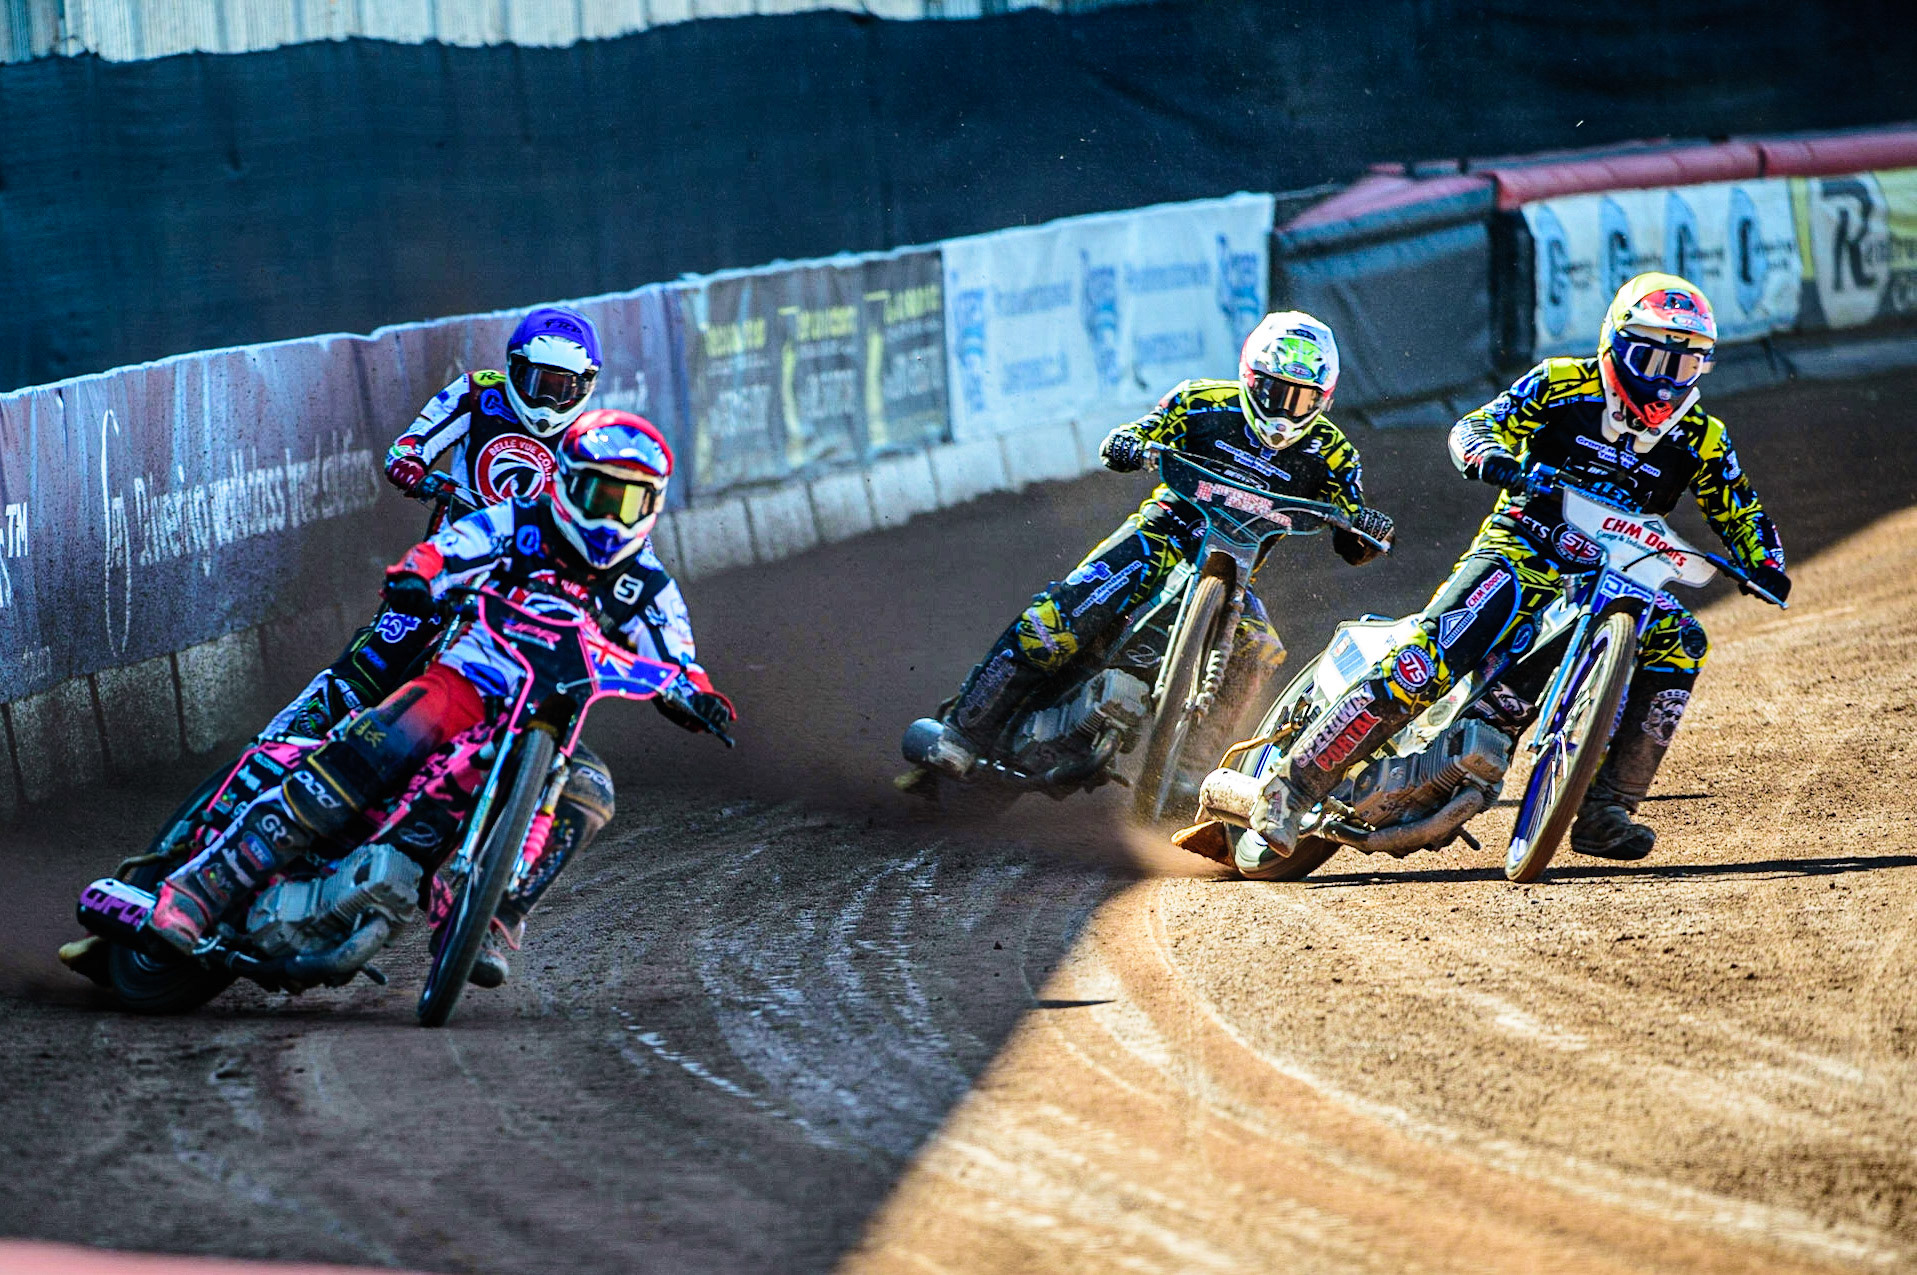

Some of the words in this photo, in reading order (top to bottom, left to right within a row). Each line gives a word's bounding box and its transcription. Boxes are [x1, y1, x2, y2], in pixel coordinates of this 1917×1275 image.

[488, 438, 517, 457] BELLE
[519, 439, 539, 455] VUE
[1602, 516, 1643, 540] CHM
[1644, 532, 1688, 568] Doors
[1094, 560, 1143, 597] Henderson
[1467, 587, 1485, 609] CHM
[1482, 570, 1505, 590] Doors
[1400, 651, 1427, 682] STS
[1293, 681, 1376, 768] SPEEDWAY
[1314, 708, 1383, 771] PORTAL
